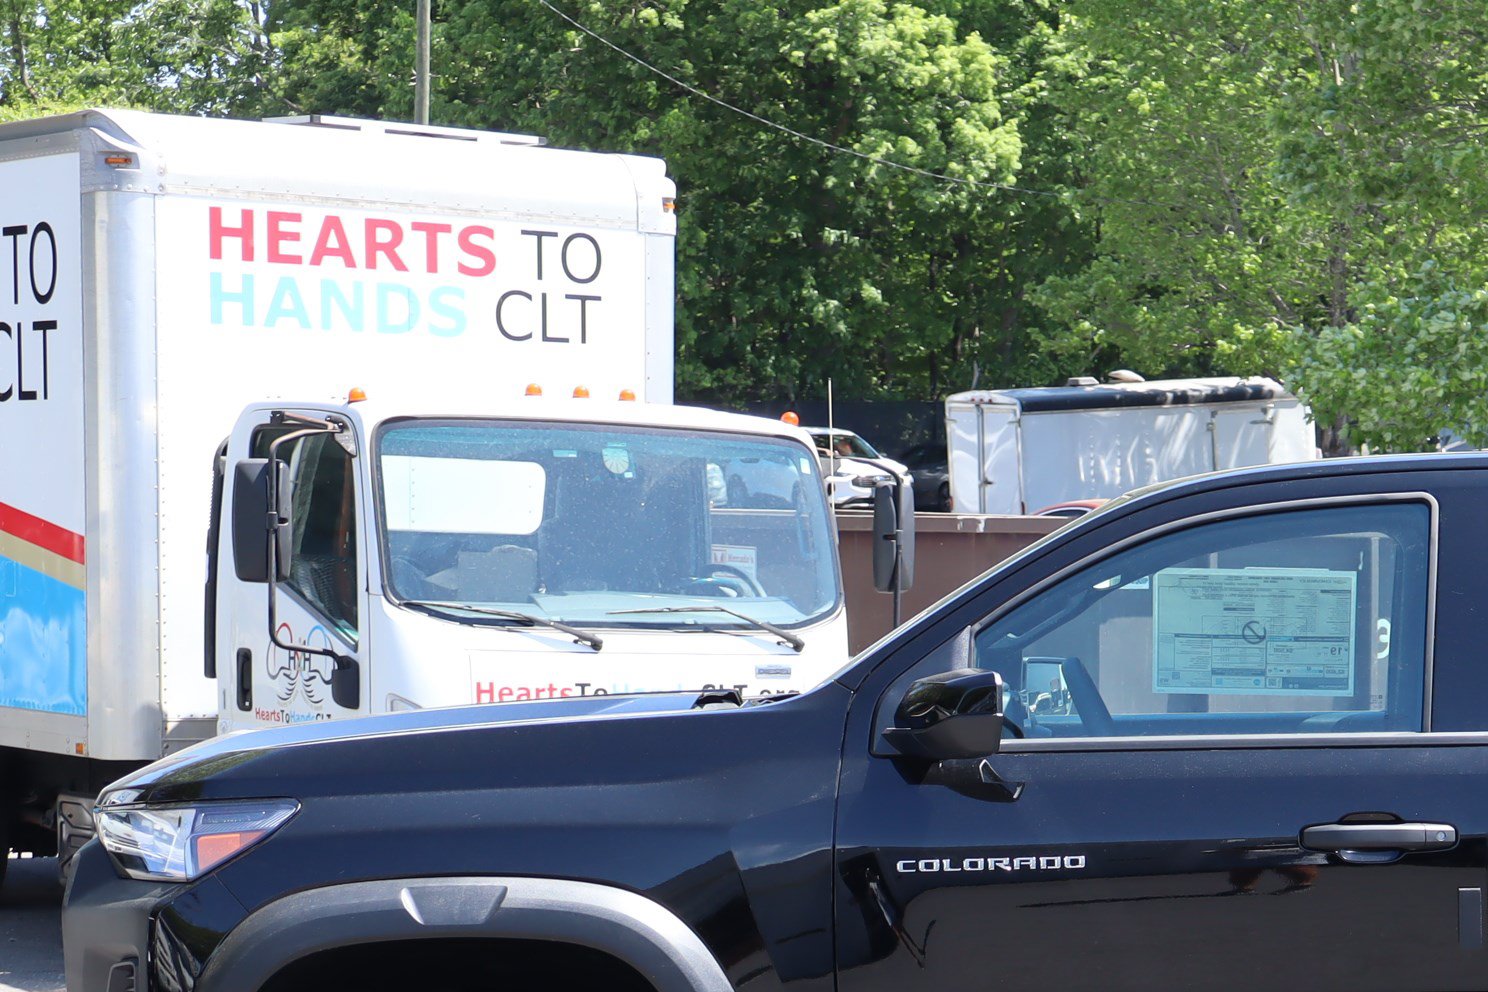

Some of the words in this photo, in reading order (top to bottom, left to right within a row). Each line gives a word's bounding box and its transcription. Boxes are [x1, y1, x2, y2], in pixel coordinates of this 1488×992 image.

[2, 221, 57, 305] TO
[208, 205, 497, 278] HEARTS
[520, 229, 603, 284] TO
[209, 271, 468, 338] HANDS
[495, 290, 602, 344] CLT
[896, 855, 1086, 873] COLORADO
